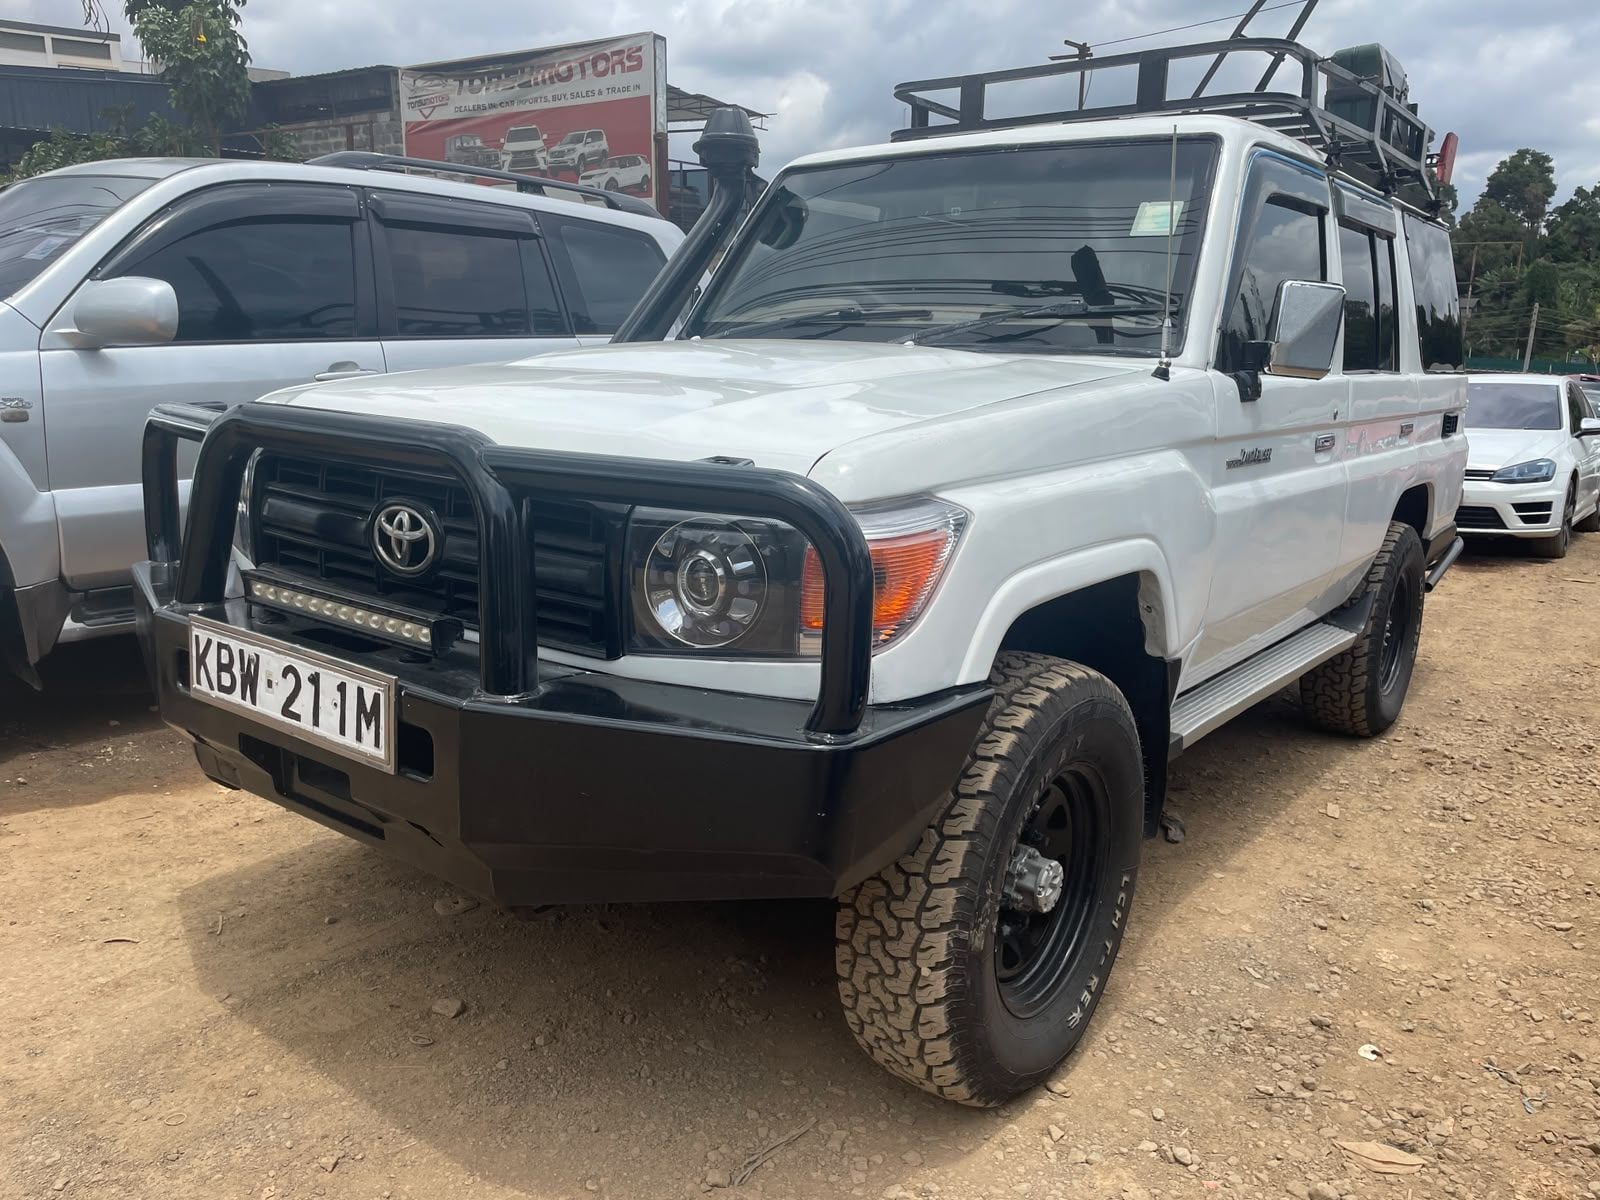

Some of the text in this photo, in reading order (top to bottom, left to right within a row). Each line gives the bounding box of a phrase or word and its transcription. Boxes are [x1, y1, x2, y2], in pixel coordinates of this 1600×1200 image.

[454, 102, 487, 113] DEALERS
[499, 99, 515, 109] CAR
[570, 89, 596, 100] SALES
[606, 85, 631, 96] TRADE
[633, 83, 641, 91] IN
[194, 634, 381, 749] KBW 211M
